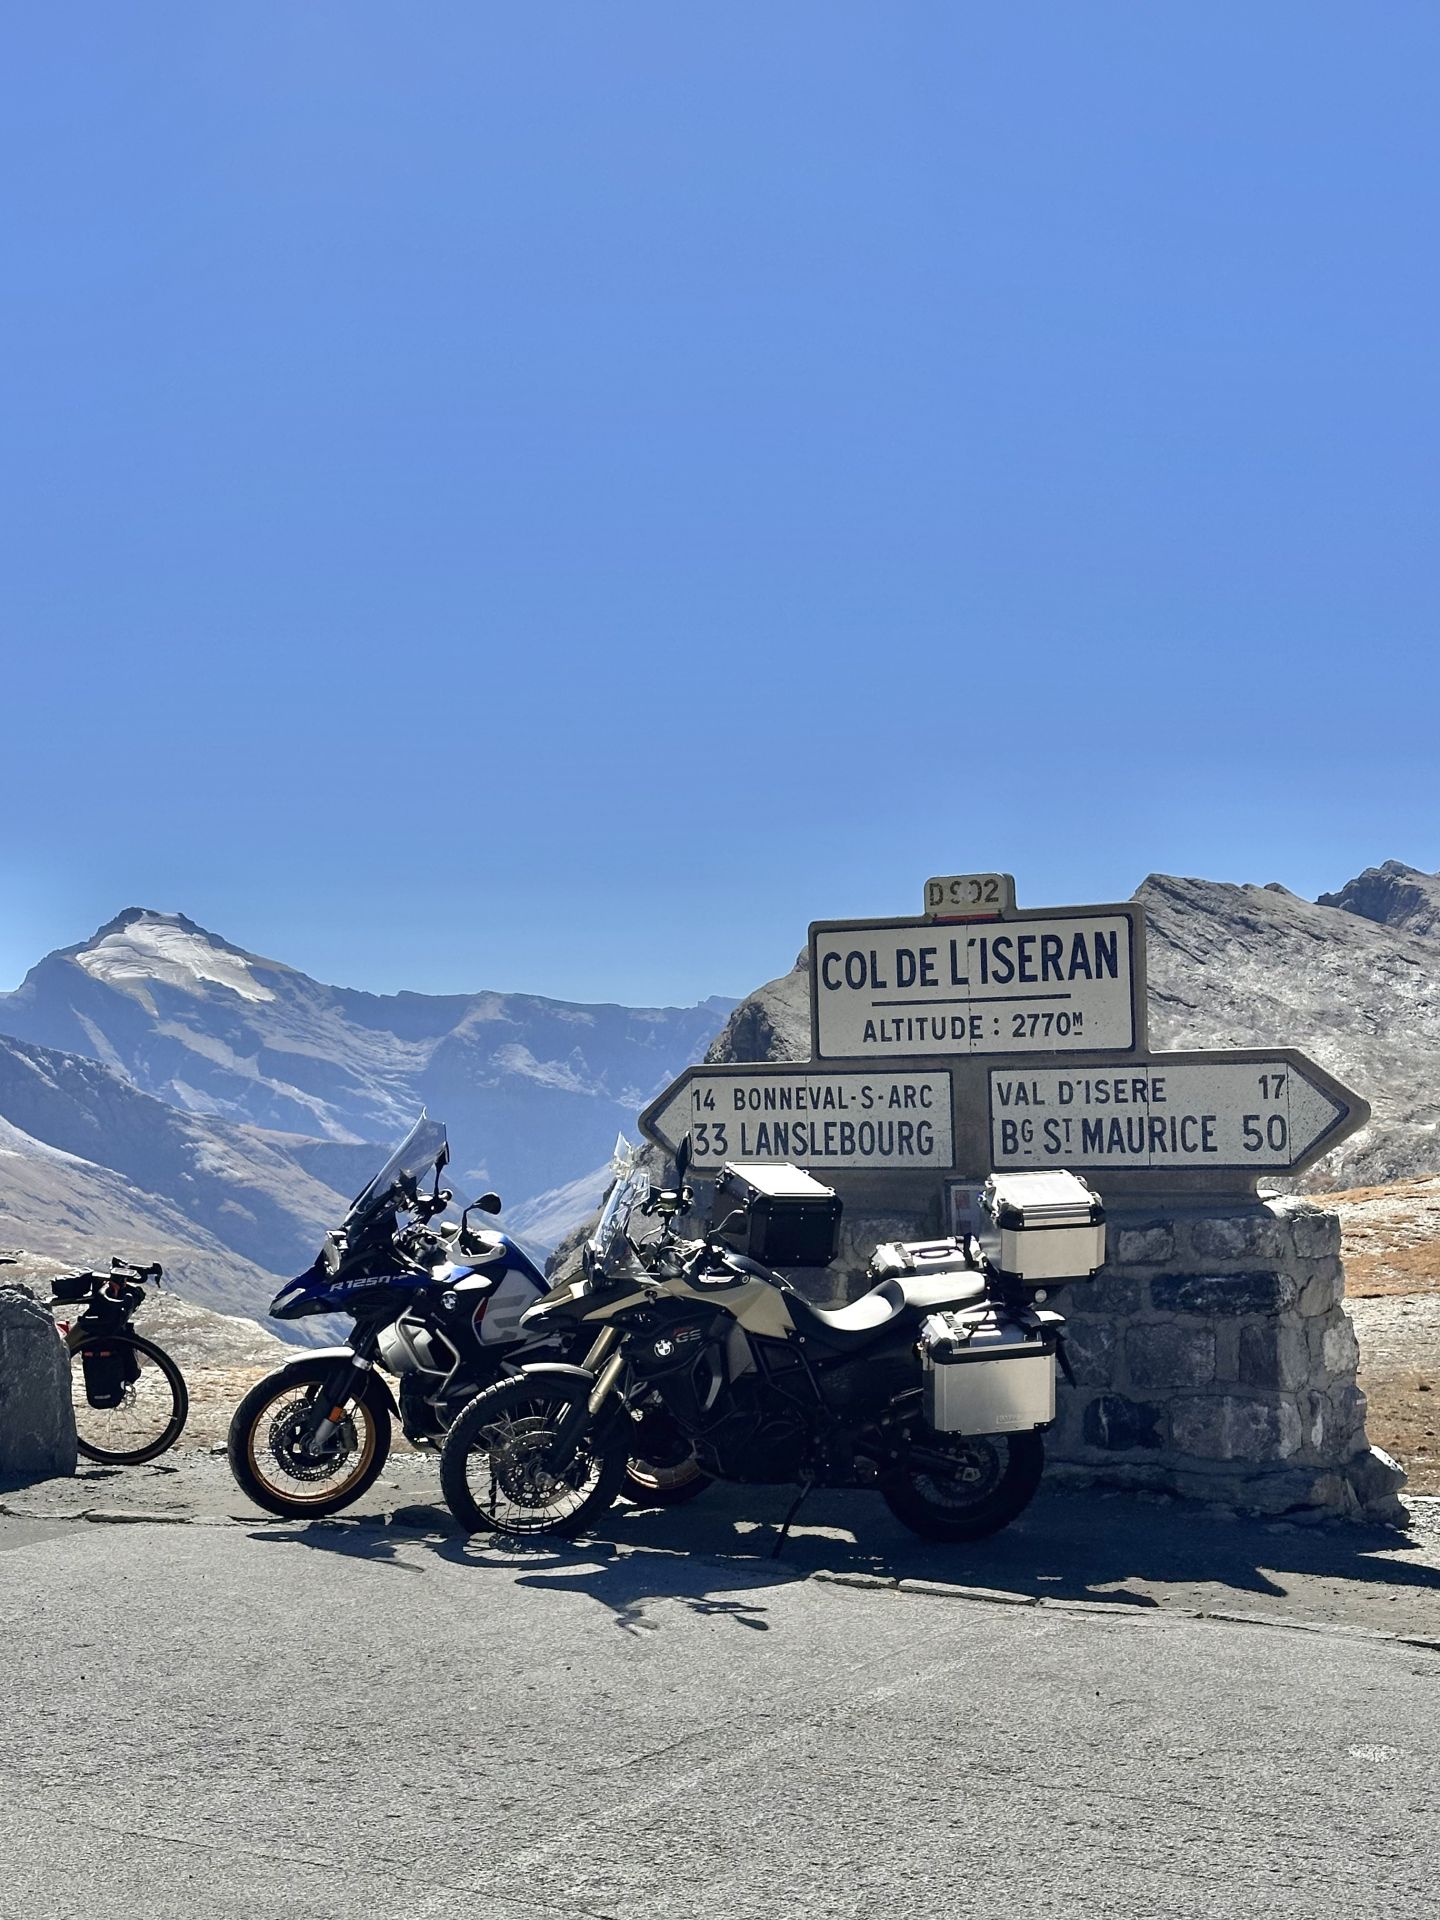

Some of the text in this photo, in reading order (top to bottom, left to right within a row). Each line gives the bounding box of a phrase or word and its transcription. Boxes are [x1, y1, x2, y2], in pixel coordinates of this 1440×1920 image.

[822, 931, 1118, 990] COL DE L'ISERAN
[863, 1016, 983, 1042] ALTITUDE
[693, 1089, 715, 1111] 14
[997, 1075, 1285, 1106] VAL D'ISERE 17
[694, 1120, 933, 1156] 33 LANSLEBOURG
[1082, 1115, 1217, 1153] MAURICE
[1243, 1115, 1287, 1151] 50
